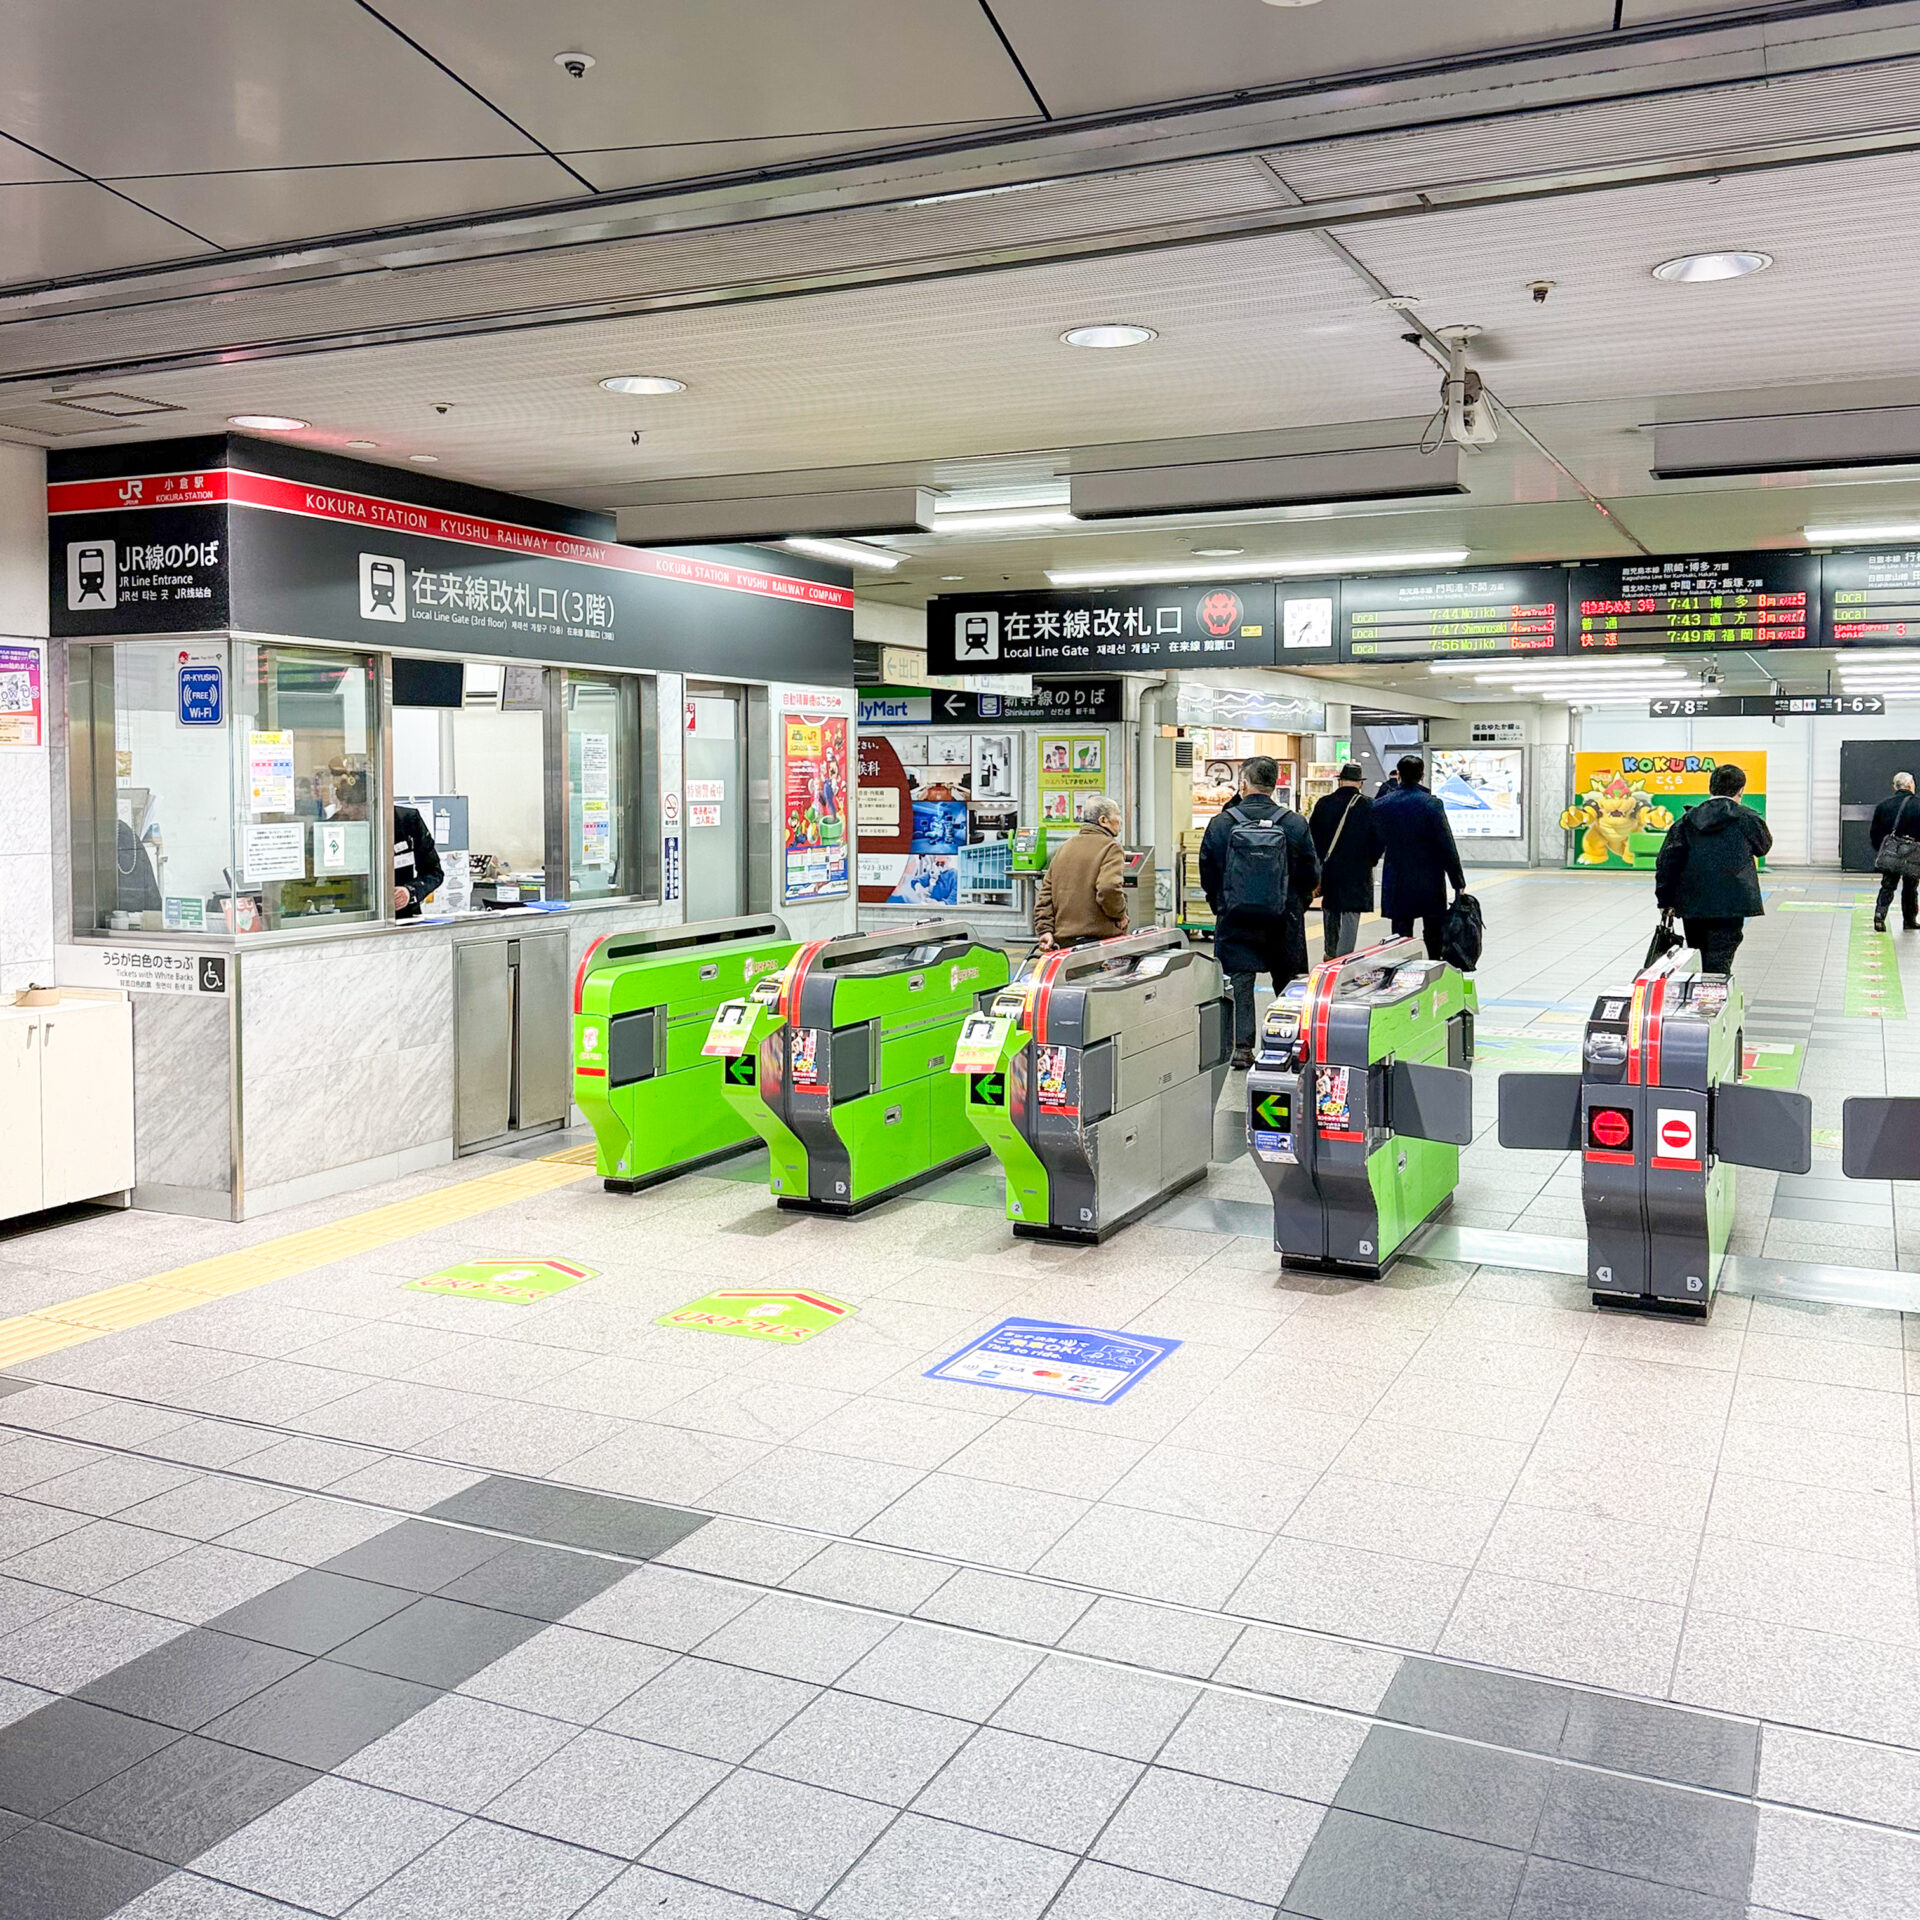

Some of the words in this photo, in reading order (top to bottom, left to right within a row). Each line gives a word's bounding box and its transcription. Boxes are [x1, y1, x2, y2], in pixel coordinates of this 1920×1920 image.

[119, 480, 143, 500] JR
[165, 476, 204, 491] 小倉駅
[156, 493, 183, 502] KOKURA
[184, 491, 213, 500] STATION
[306, 493, 366, 518] KOKURA
[371, 505, 427, 529] STATION
[440, 519, 490, 540] KYUSHU
[497, 529, 549, 551] RAILWAY
[555, 540, 607, 561] COMPANY
[119, 540, 219, 572] JR線のりば
[119, 576, 130, 588] JR
[131, 575, 151, 587] Line
[152, 574, 194, 586] Entrance
[656, 558, 693, 578] KOKURA
[695, 565, 730, 584] STATION
[737, 574, 768, 591] KYUSHU
[772, 581, 805, 597] RAILWAY
[809, 587, 842, 604] COMPANY
[119, 591, 139, 602] JR선
[142, 590, 158, 601] 타는
[161, 590, 169, 600] 곳
[1834, 590, 1867, 604] Local
[1580, 600, 1632, 615] 特急きらめき
[1637, 598, 1656, 613] 3号
[1667, 597, 1700, 610] 7:41
[1710, 595, 1749, 609] 博多
[412, 608, 433, 621] Local
[434, 611, 450, 623] Line
[452, 613, 470, 625] Gate
[471, 615, 486, 627] (3rd
[487, 617, 508, 630] floor)
[1351, 612, 1379, 624] Local
[1430, 608, 1460, 620] 7:44
[1461, 608, 1496, 619] Mojiko
[1581, 616, 1618, 631] 普通
[1667, 613, 1701, 627] 7:43
[1710, 611, 1748, 625] 直方
[1833, 608, 1867, 621] Local
[1003, 606, 1182, 642] 在来線改札口
[1895, 622, 1906, 637] 3
[1351, 626, 1379, 640] Local
[1429, 624, 1460, 636] 7:47
[1580, 632, 1618, 647] 快速
[1667, 630, 1701, 643] 7:49
[1703, 628, 1754, 642] 南福岡
[1834, 631, 1865, 639] Sonic
[1004, 646, 1033, 659] Local
[1035, 645, 1059, 658] Line
[1061, 645, 1090, 657] Gate
[1096, 641, 1126, 655] 재래선
[1130, 641, 1161, 654] 개찰구
[1351, 642, 1379, 655] Local
[1429, 639, 1460, 652] 7:56
[1461, 639, 1496, 650] Mojiko
[899, 657, 920, 679] 出口
[182, 673, 219, 682] JR-KYUSHU
[192, 691, 209, 700] FREE
[189, 707, 212, 718] Wi-Fi
[1004, 709, 1044, 717] Shinkansen
[1622, 756, 1717, 774] KOKURA
[1656, 776, 1684, 785] こくら
[687, 783, 724, 799] 特別警戒中
[695, 815, 716, 825] 立入禁止
[102, 952, 194, 971] うらが白色のきっぷ
[116, 969, 137, 978] Tickets
[138, 970, 154, 979] with
[154, 971, 175, 981] White
[175, 972, 194, 982] Backs
[1015, 1204, 1020, 1212] 2
[1083, 1210, 1088, 1218] 3
[1362, 1244, 1368, 1252] 4
[1602, 1270, 1608, 1278] 4
[1690, 1280, 1697, 1288] 5
[986, 1343, 1012, 1353] Tap
[1031, 1349, 1063, 1359] ride.
[993, 1364, 1025, 1373] VISA
